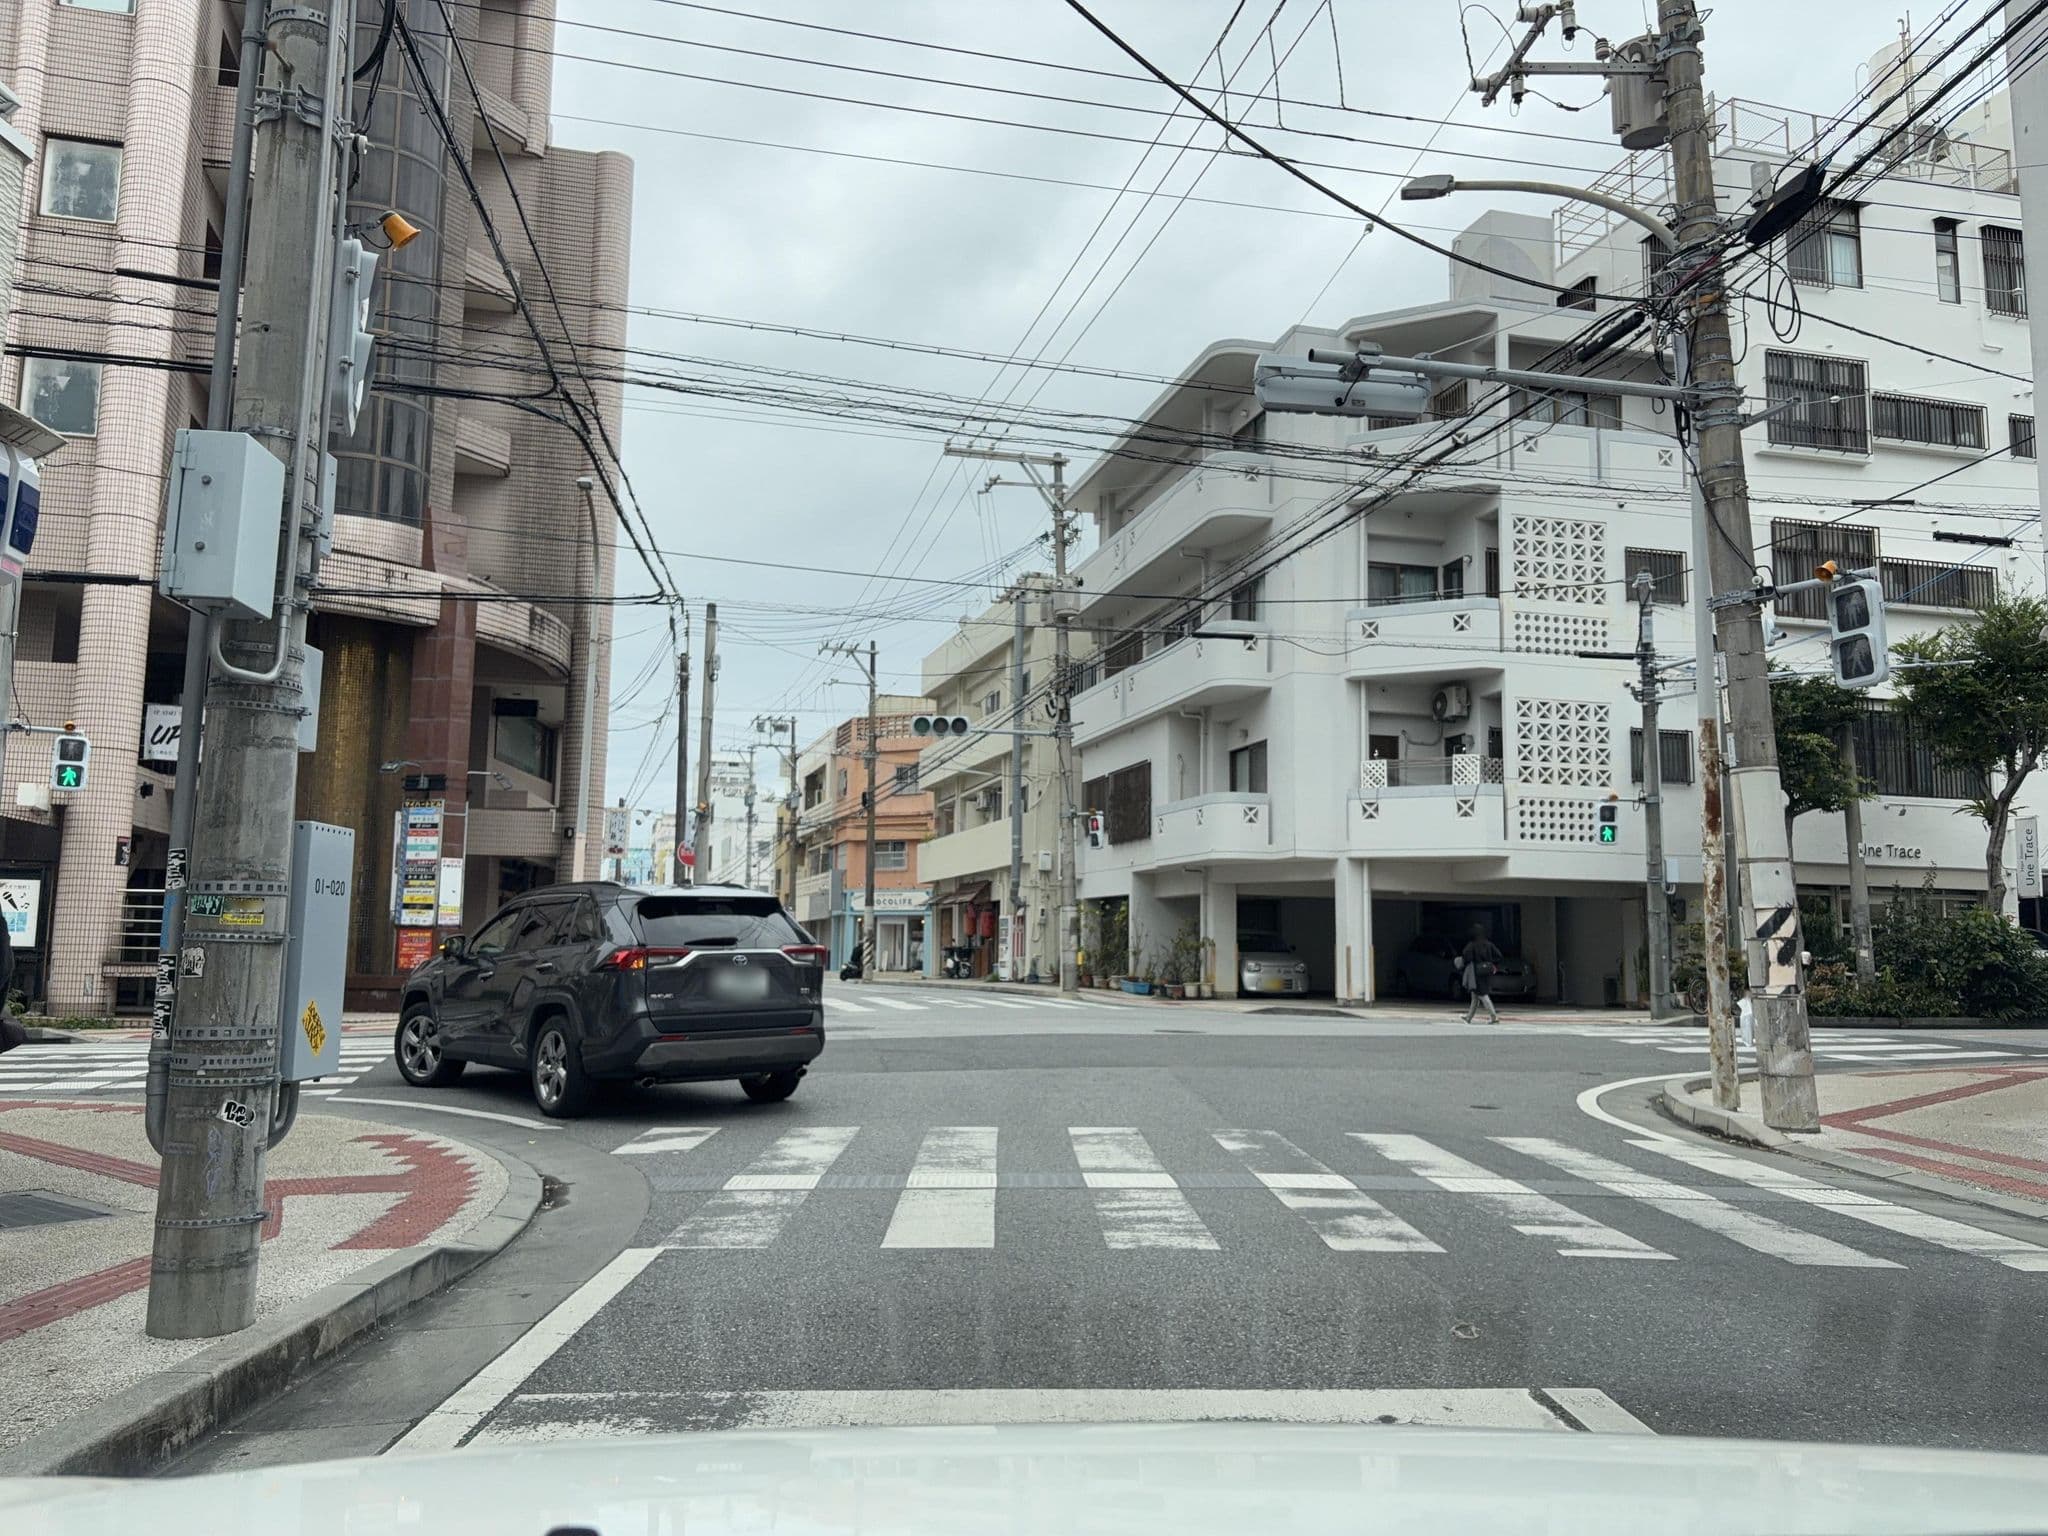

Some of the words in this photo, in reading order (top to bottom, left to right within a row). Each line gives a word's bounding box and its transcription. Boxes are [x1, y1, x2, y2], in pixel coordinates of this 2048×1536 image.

[1886, 844, 1921, 859] Trace
[2024, 828, 2034, 860] Trace
[2025, 864, 2035, 886] Une
[315, 878, 346, 896] 01-020
[875, 898, 913, 906] OCOLIFE
